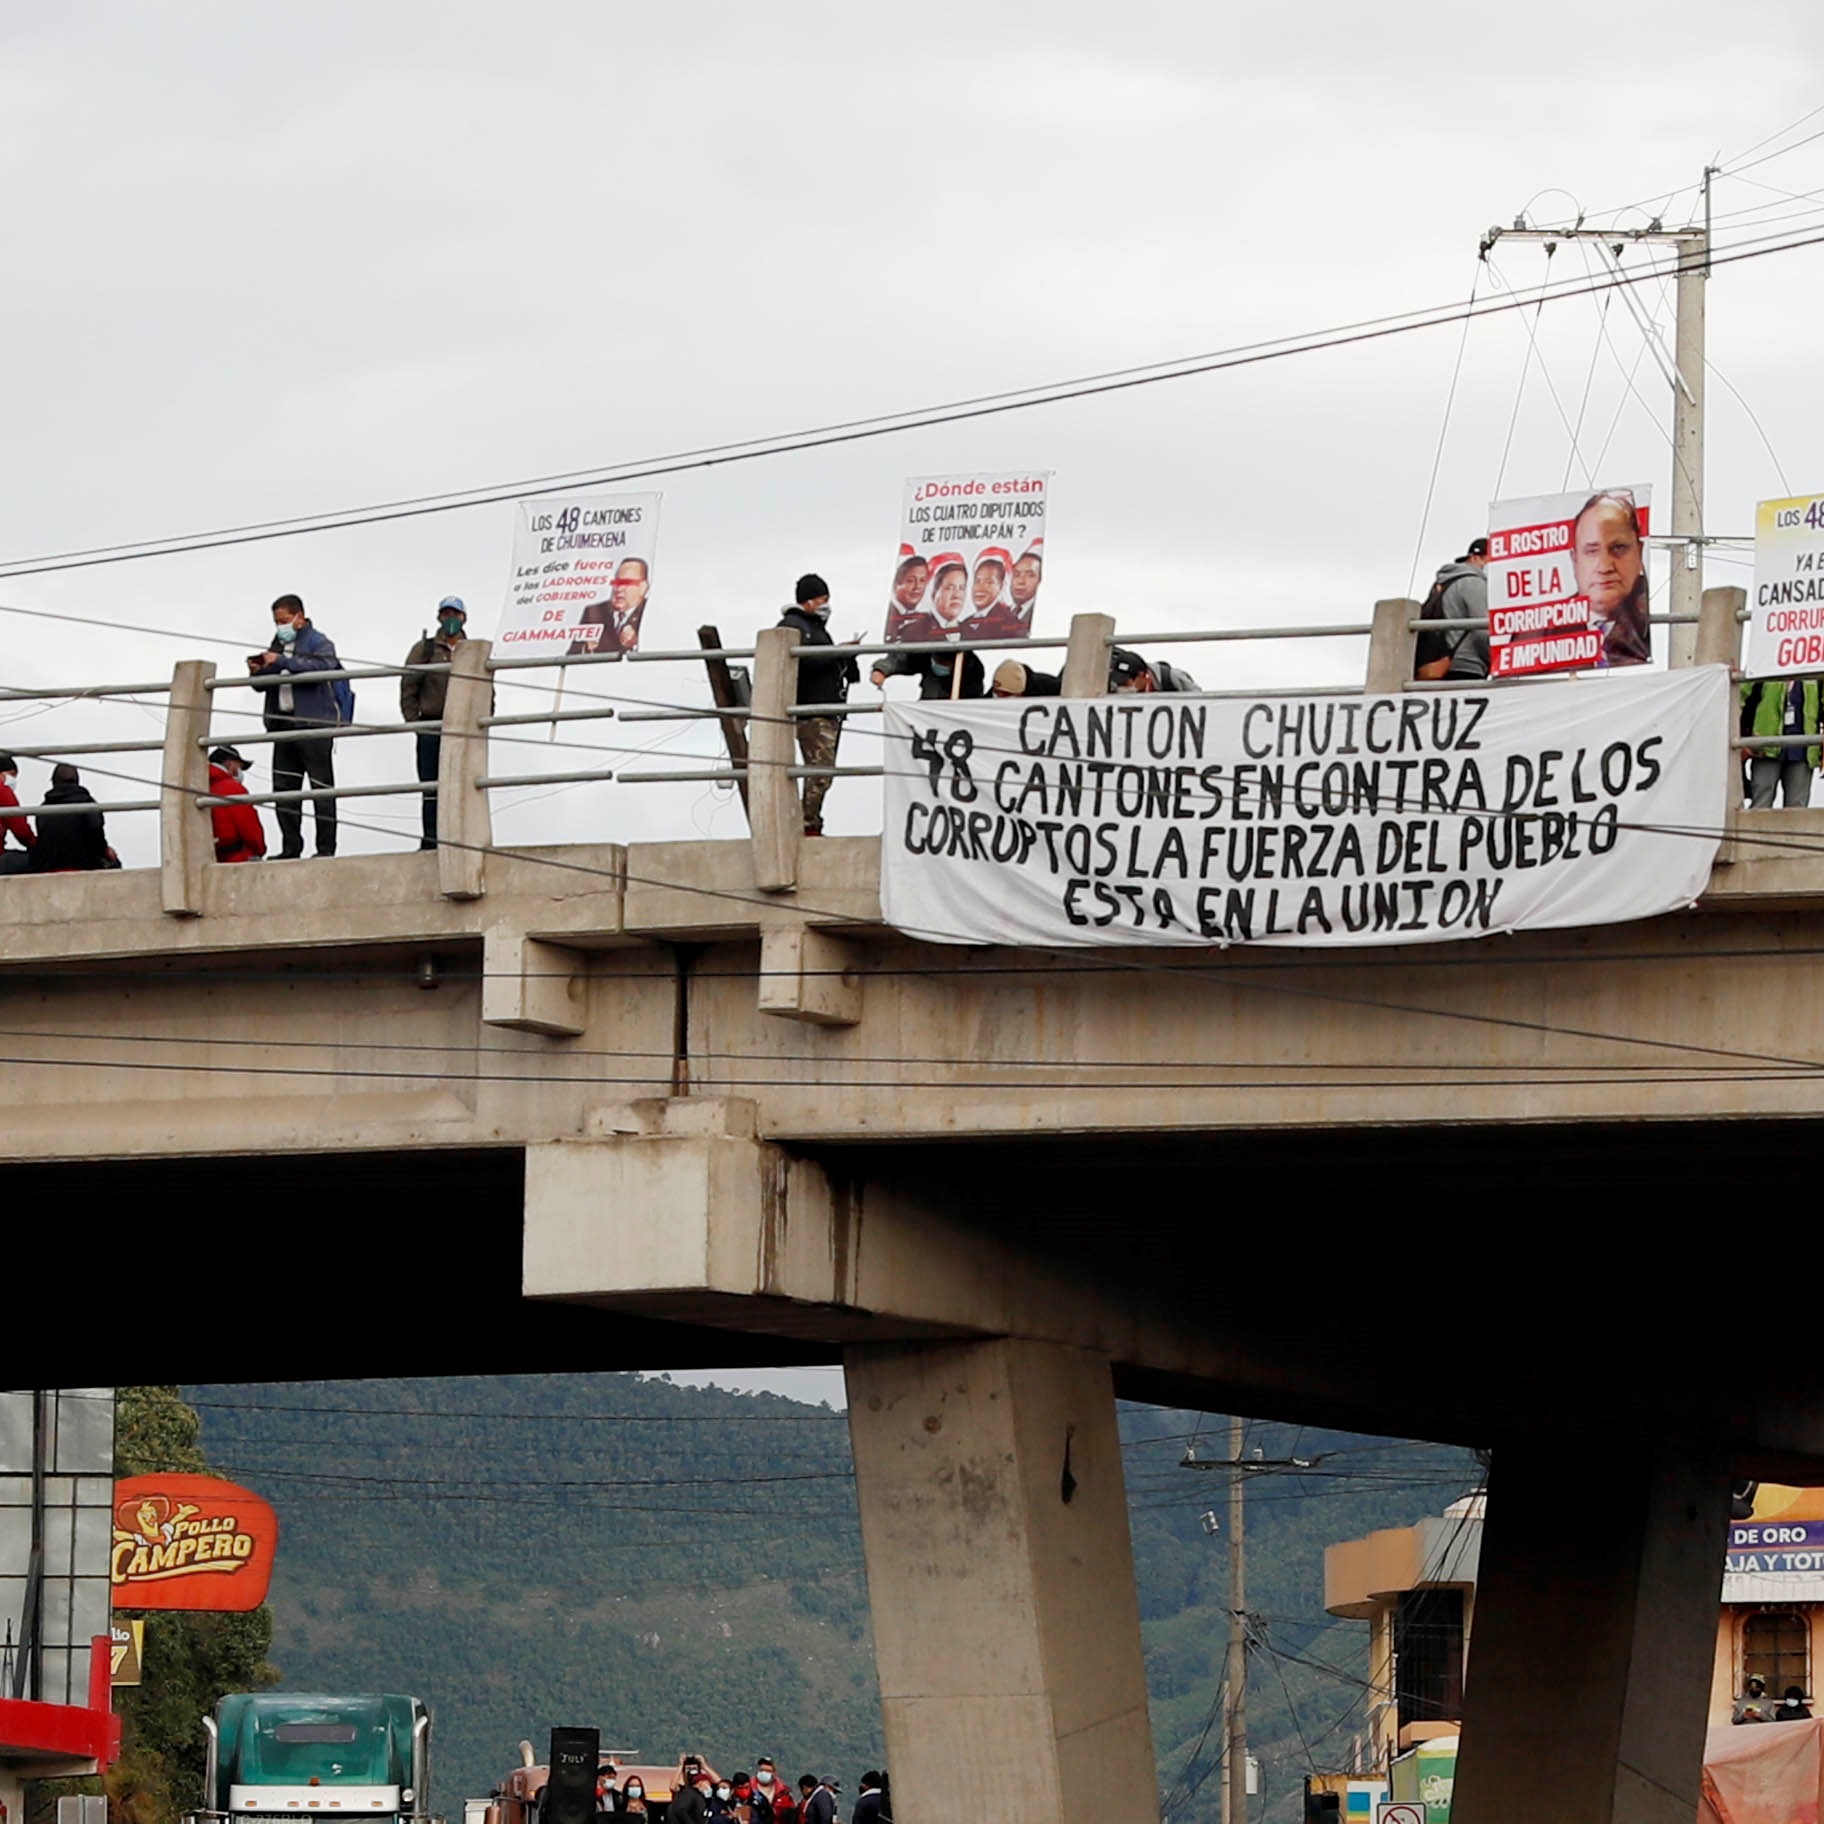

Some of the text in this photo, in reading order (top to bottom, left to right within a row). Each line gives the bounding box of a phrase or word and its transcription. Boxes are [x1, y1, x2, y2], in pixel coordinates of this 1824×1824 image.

[914, 477, 1044, 502] ¿Dónde están
[531, 506, 643, 534] LOS 48 CANTONES
[909, 501, 1045, 524] LOS CUATRO DIPUTADOS
[1777, 510, 1800, 528] LOS
[922, 521, 1027, 543] DE TOTONICAPÁN ?
[1490, 525, 1569, 557] EL ROSTRO
[540, 537, 555, 553] DE
[516, 559, 614, 577] Les dice fuera
[1795, 554, 1813, 572] YA
[542, 576, 608, 589] LADRONES
[1507, 567, 1562, 598] DE LA
[536, 590, 597, 603] GOBIERNO
[543, 610, 565, 622] DE
[1493, 598, 1589, 634] CORRUPCIÓN
[1500, 635, 1599, 670] E IMPUNIDAD
[1019, 698, 1489, 760] CANTON CHUICRUZ
[910, 725, 1663, 820] 48 CANTONES EN CONTRA DE LOS
[904, 802, 1619, 883] CORRUPTOS LA FUERZA DEL PUEBLO
[1063, 877, 1504, 939] ESTA EN LA UNION
[173, 1516, 236, 1539] POLLO
[1734, 1527, 1807, 1544] DE ORO
[111, 1534, 253, 1584] CAMPERO
[1763, 1555, 1779, 1570] Y
